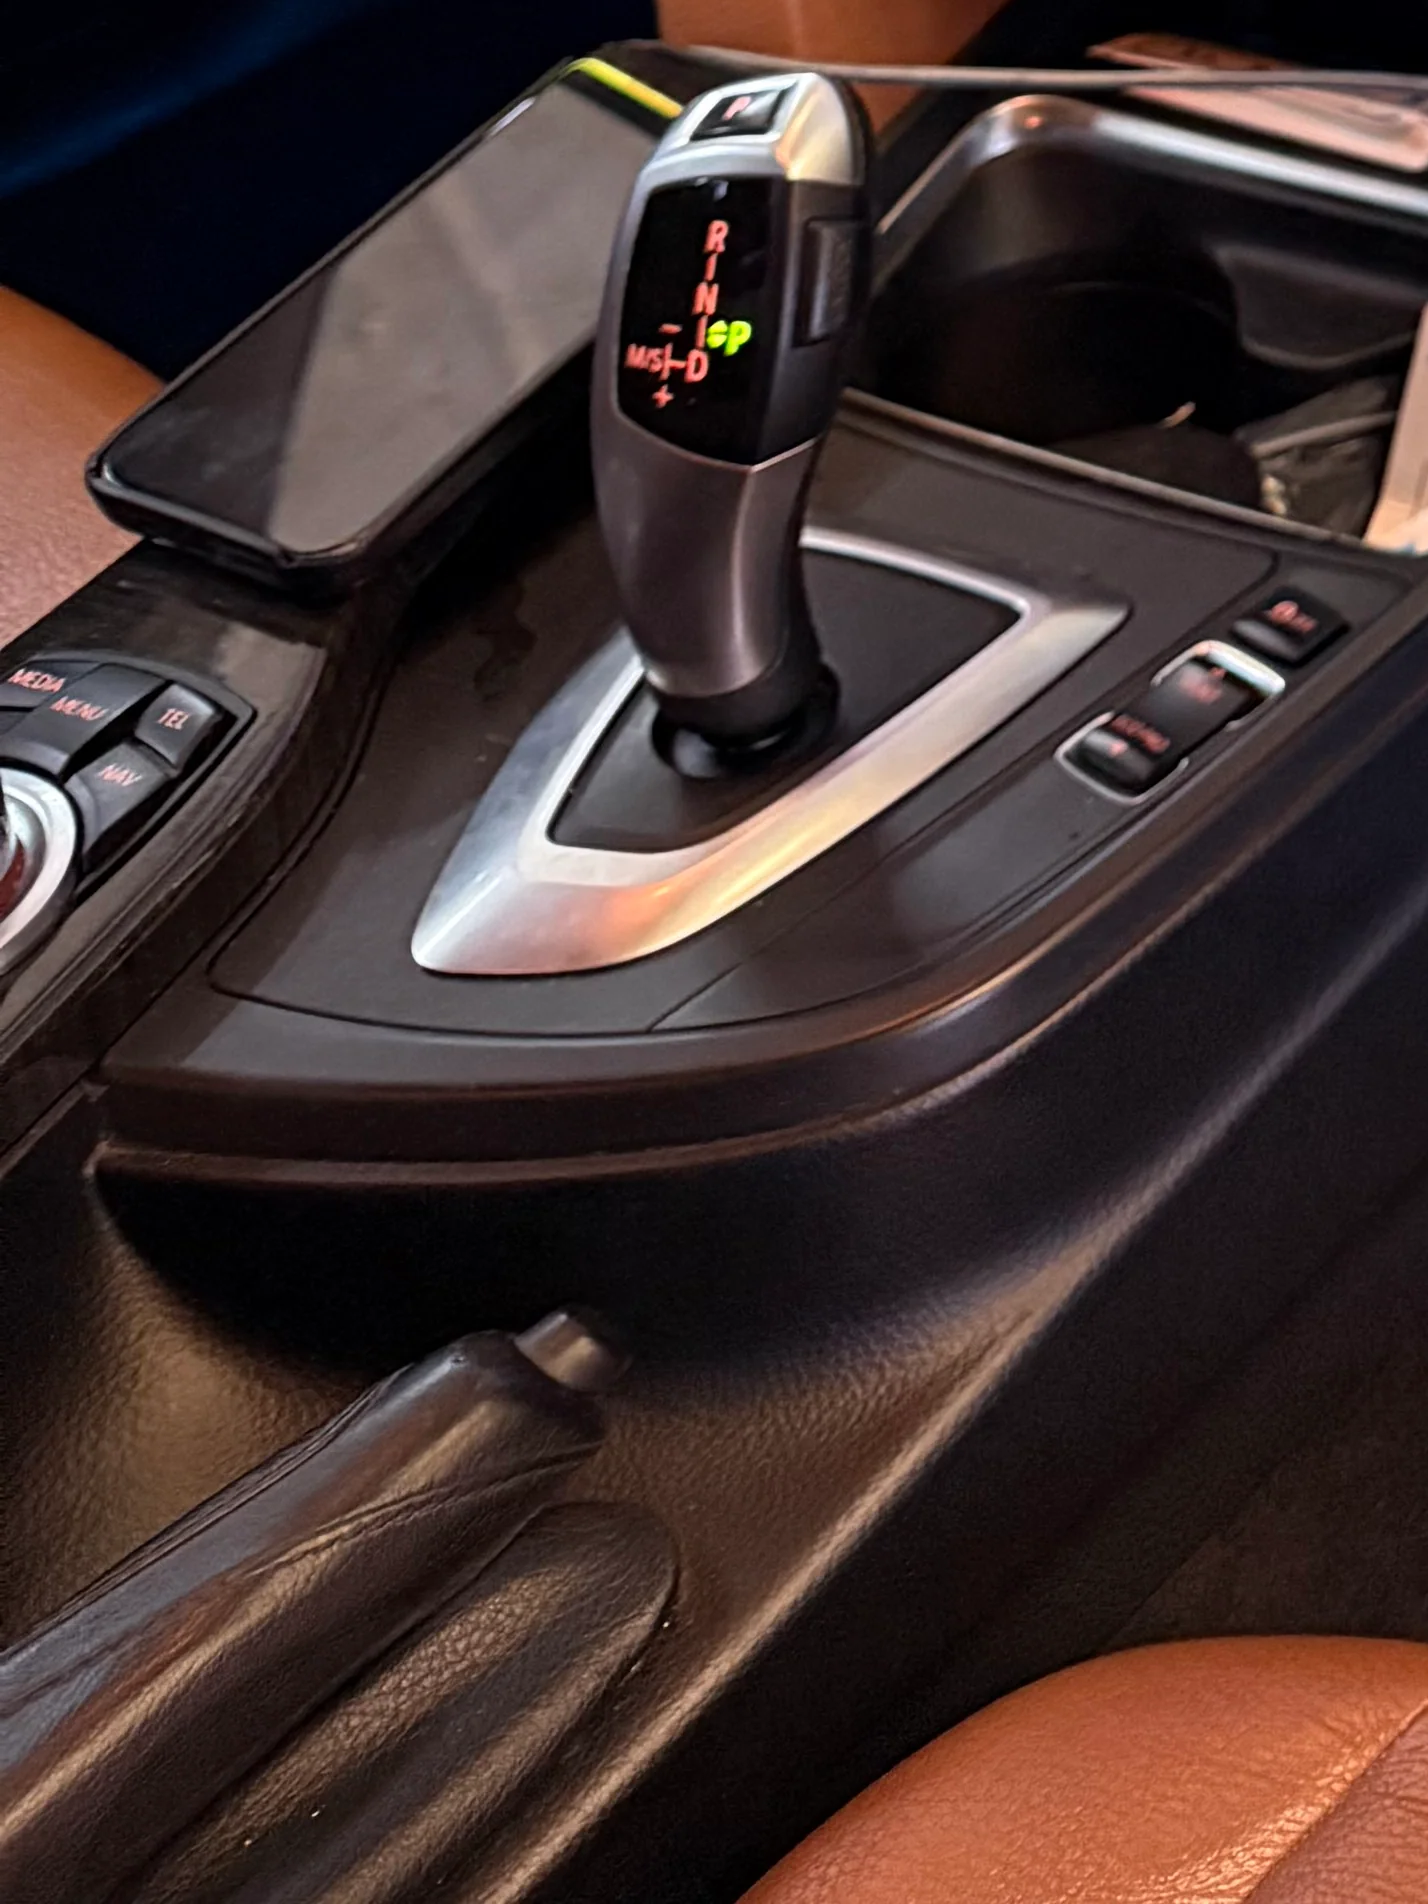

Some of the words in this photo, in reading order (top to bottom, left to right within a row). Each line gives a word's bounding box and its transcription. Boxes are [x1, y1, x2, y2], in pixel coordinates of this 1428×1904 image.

[704, 220, 729, 253] R
[692, 282, 719, 316] N
[684, 348, 709, 383] D
[7, 668, 68, 693] MEDIA
[49, 695, 110, 722] MENU
[157, 707, 193, 731] TEL
[98, 763, 145, 787] NAV
